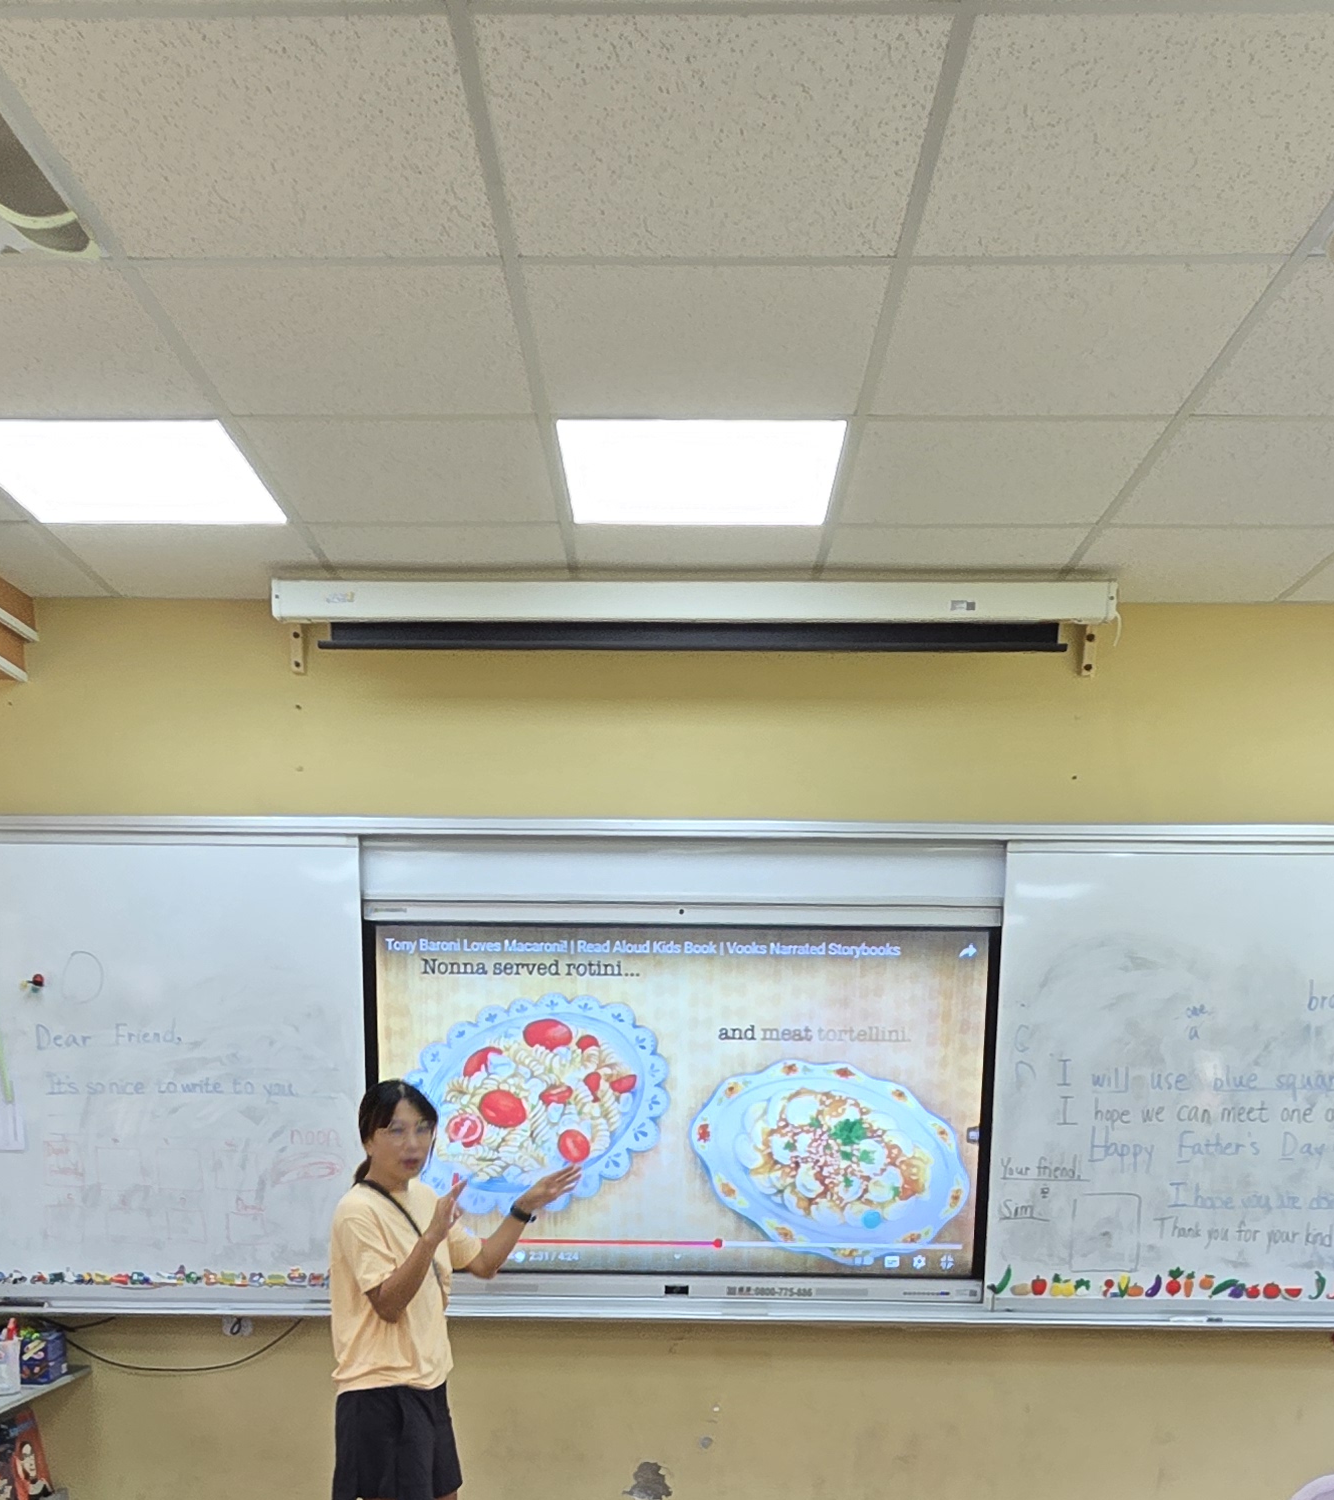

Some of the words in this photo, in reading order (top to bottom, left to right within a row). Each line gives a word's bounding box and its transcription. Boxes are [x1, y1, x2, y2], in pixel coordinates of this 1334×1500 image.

[385, 938, 416, 954] Tony
[419, 938, 460, 951] Baroni
[464, 939, 501, 952] Loves
[504, 939, 567, 952] Macaroni!
[577, 940, 610, 953] Read
[614, 940, 649, 954] Aloud
[653, 941, 680, 954] Kids
[684, 941, 717, 954] Book
[727, 942, 767, 954] Vooks
[770, 942, 825, 955] Narrated
[828, 943, 901, 958] Storybooks
[422, 958, 487, 975] Nonna
[493, 959, 560, 976] served
[565, 960, 640, 977] rotini...
[36, 1024, 91, 1050] Dear
[115, 1018, 182, 1045] Friend,
[718, 1025, 757, 1041] and
[761, 1026, 813, 1042] meat
[46, 1073, 79, 1095] It's
[86, 1082, 104, 1095] so
[109, 1080, 144, 1095] nice
[181, 1078, 223, 1095] write
[233, 1079, 254, 1095] to
[1057, 1059, 1071, 1086] I
[1092, 1066, 1129, 1090] will
[1151, 1072, 1190, 1091] use
[1213, 1066, 1258, 1091] blue
[1057, 1096, 1078, 1125] I
[1094, 1099, 1131, 1131] hope
[1141, 1105, 1165, 1122] we
[1177, 1104, 1212, 1123] can
[1221, 1102, 1269, 1124] meet
[1281, 1105, 1314, 1124] one
[1088, 1126, 1155, 1172] Happy
[1177, 1131, 1261, 1162] Father's
[1000, 1157, 1030, 1179] Your
[1168, 1182, 1187, 1207] I
[1153, 1216, 1201, 1239] Thank
[1205, 1229, 1229, 1249] you
[1236, 1221, 1260, 1242] for
[1267, 1228, 1300, 1253] your
[1304, 1222, 1333, 1248] kind
